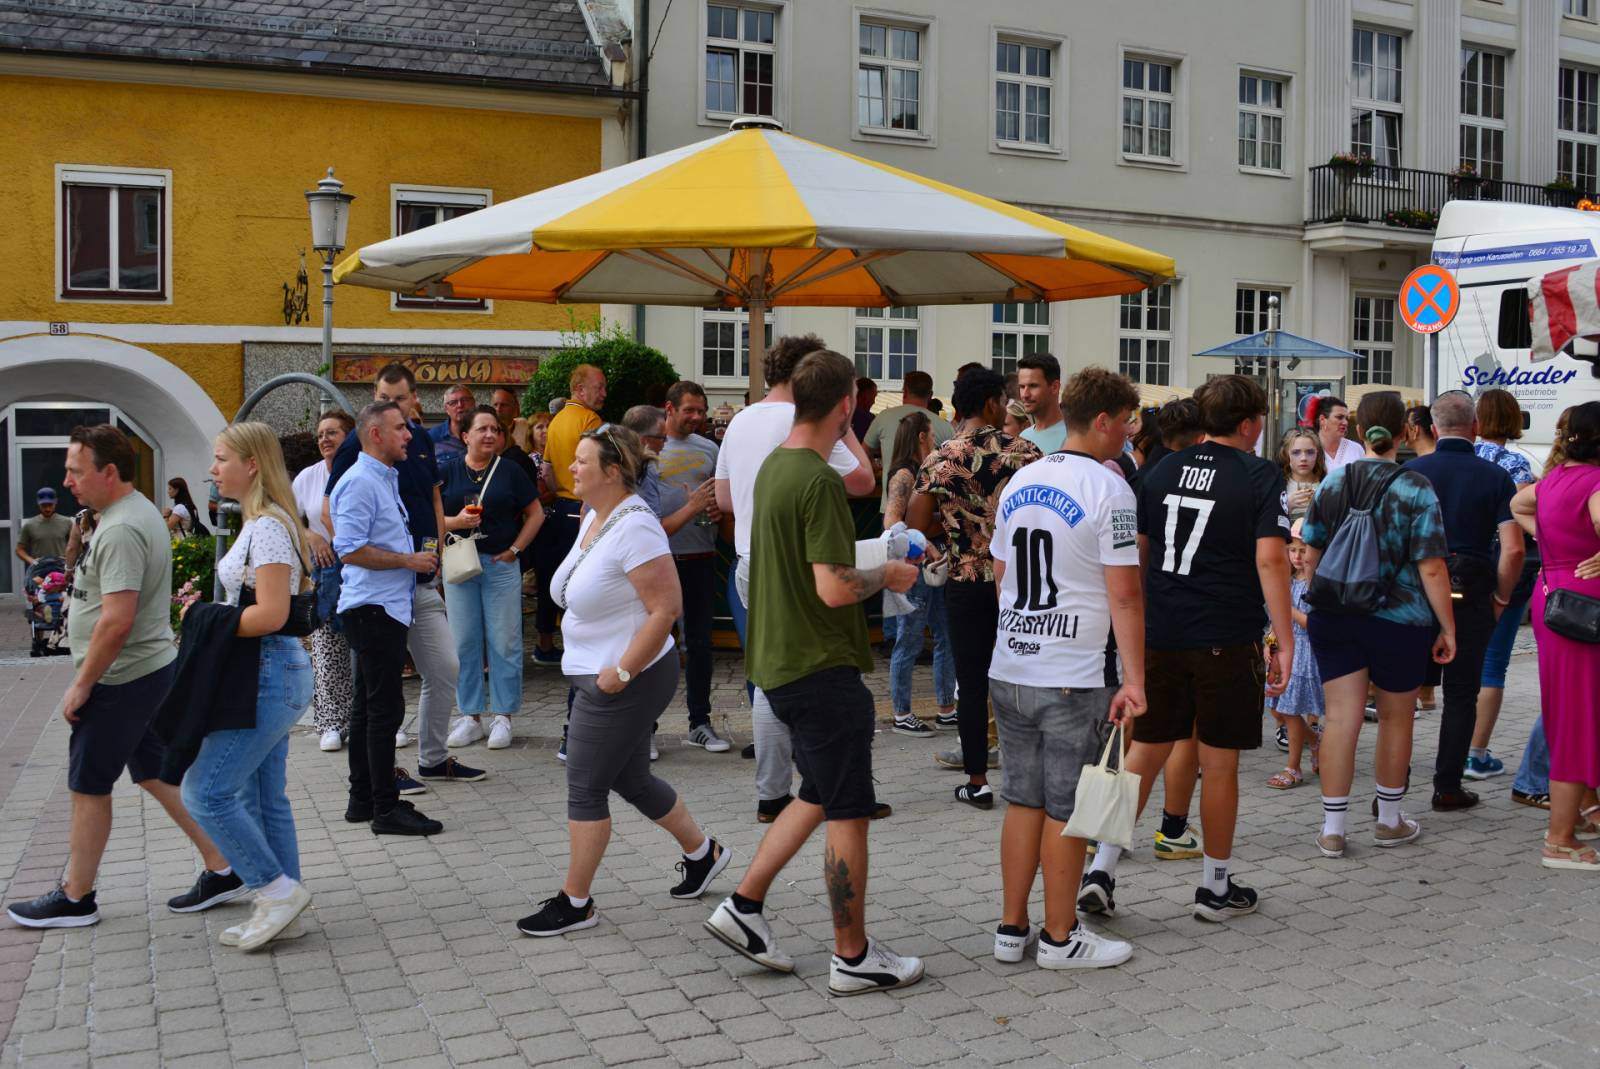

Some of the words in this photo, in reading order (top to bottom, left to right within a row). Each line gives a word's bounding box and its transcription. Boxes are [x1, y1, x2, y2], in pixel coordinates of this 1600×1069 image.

[1528, 248, 1547, 257] 0664
[52, 323, 66, 334] 58
[1412, 320, 1443, 331] ANFANG
[1462, 365, 1577, 387] Schlader
[1178, 465, 1216, 492] TOBI
[1003, 487, 1078, 521] PUNTIGAMER
[1161, 493, 1216, 576] 17
[1012, 527, 1059, 611] 10
